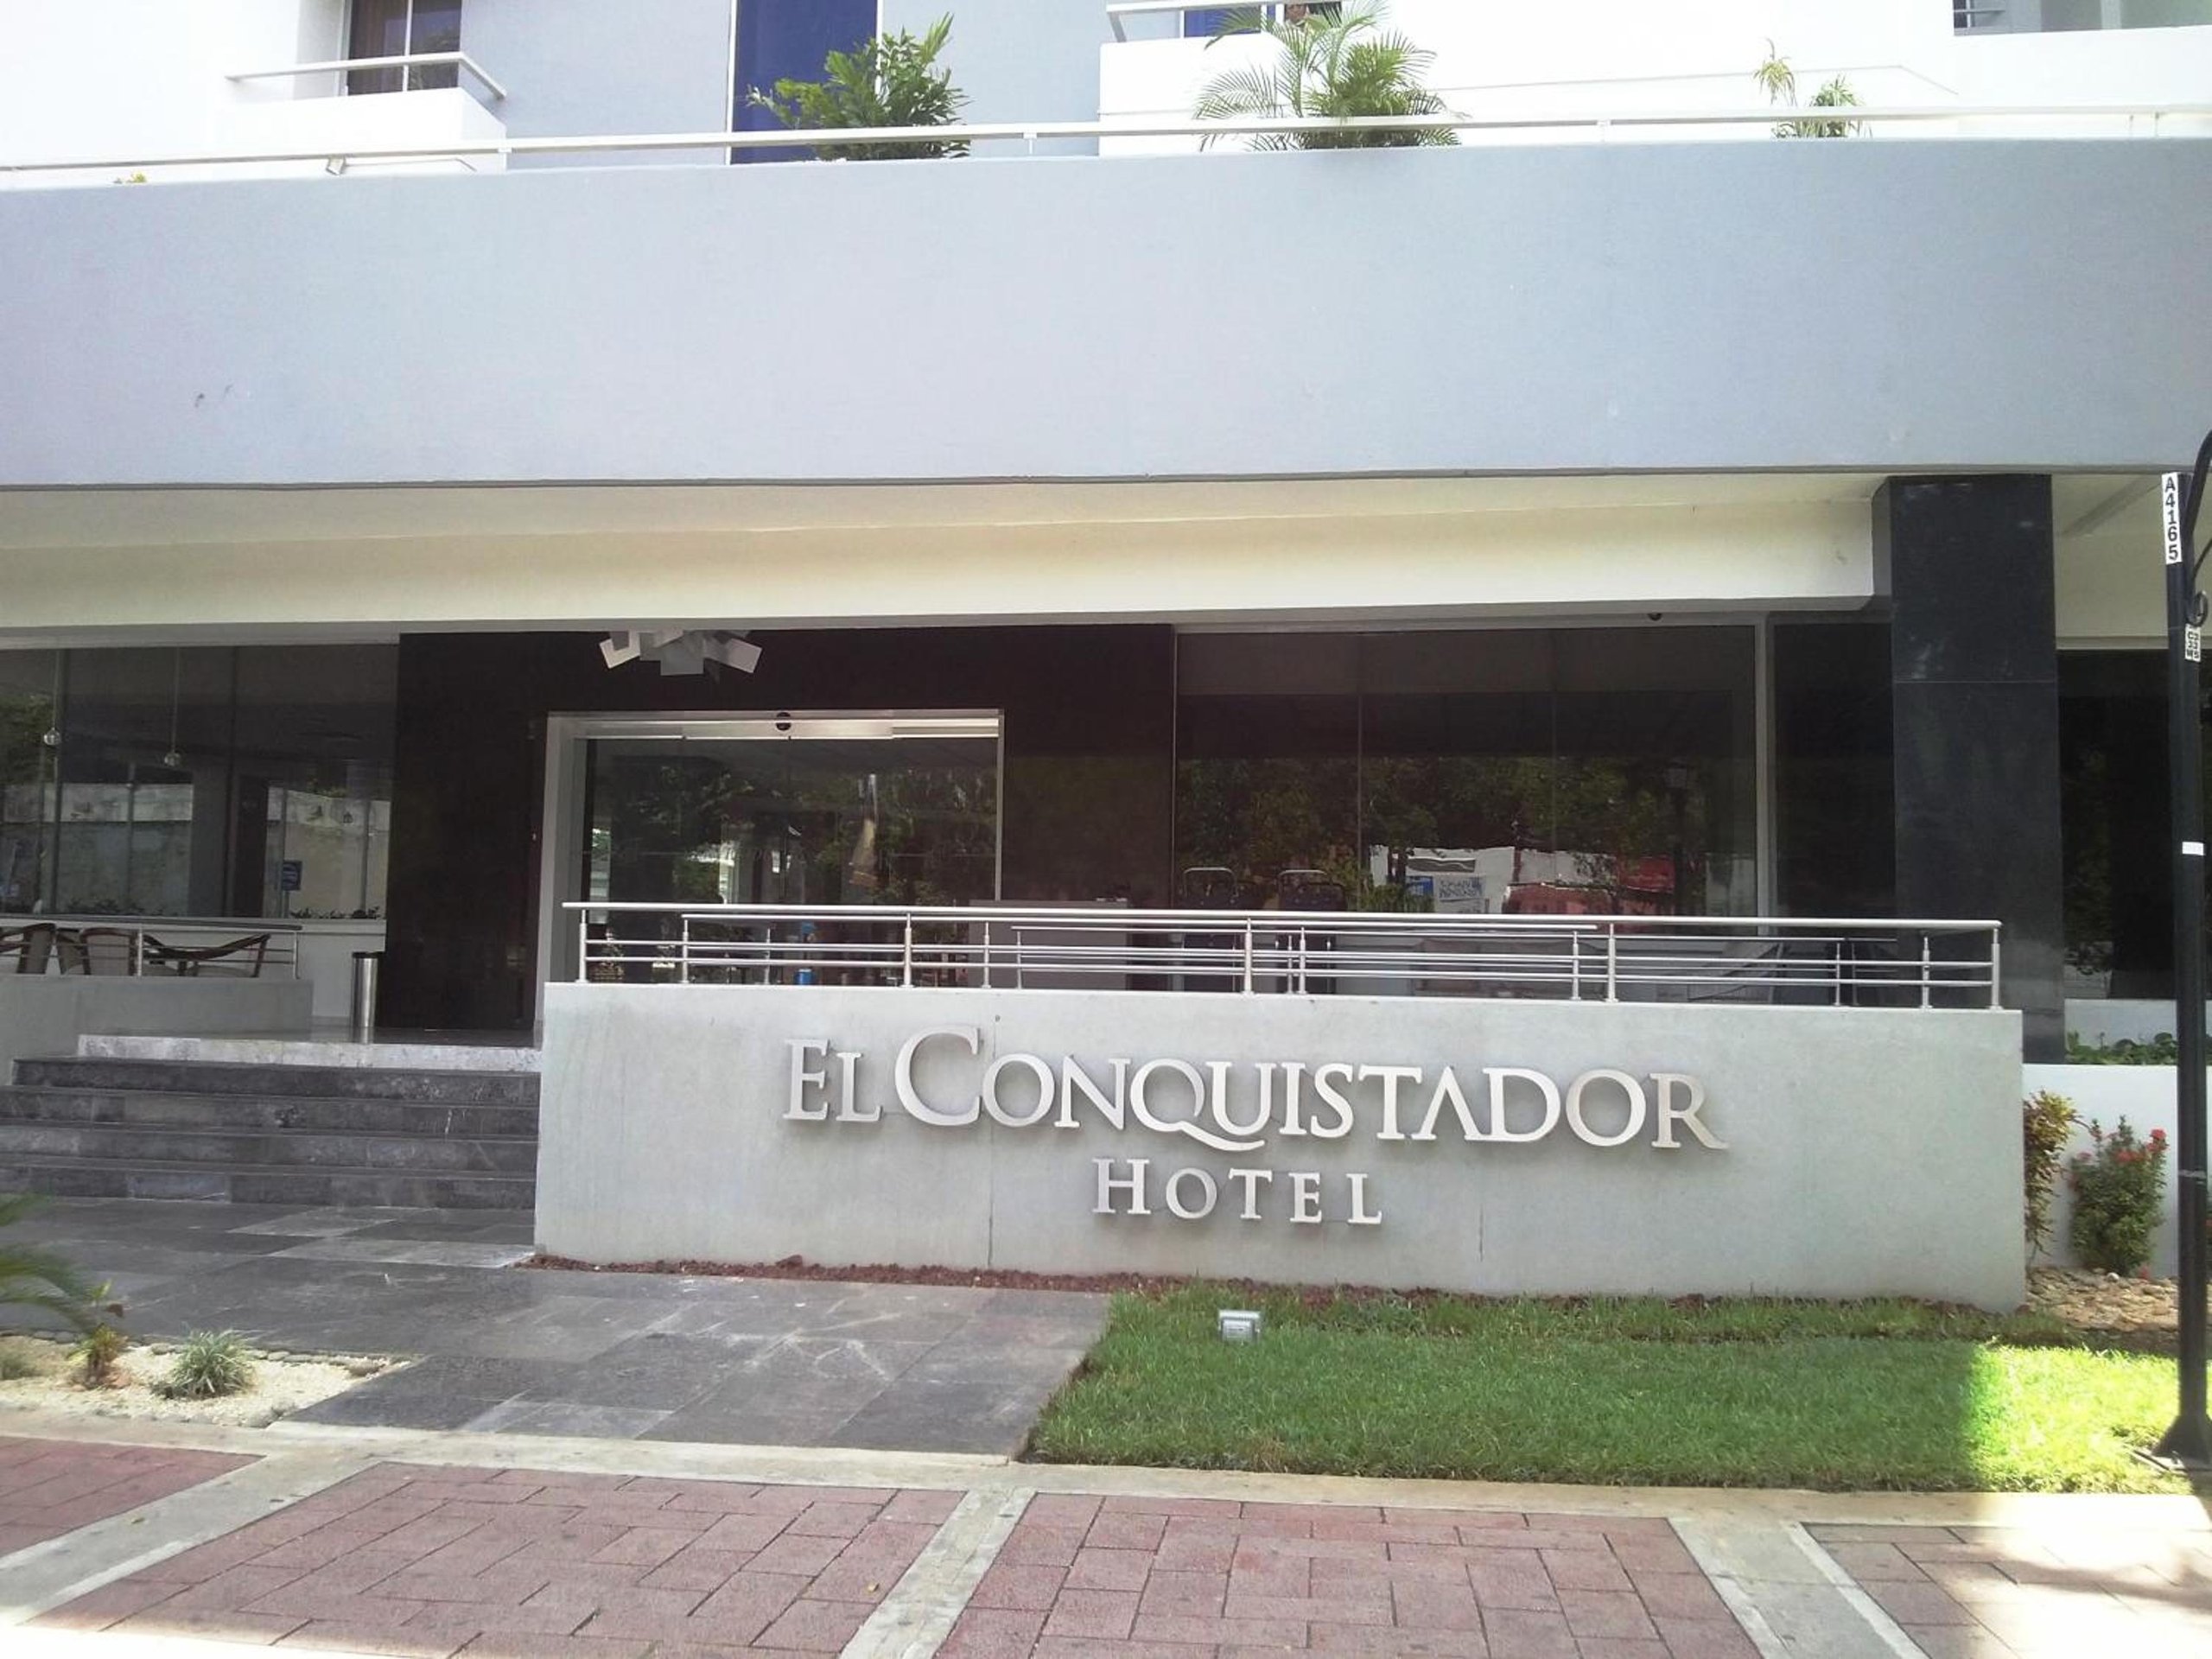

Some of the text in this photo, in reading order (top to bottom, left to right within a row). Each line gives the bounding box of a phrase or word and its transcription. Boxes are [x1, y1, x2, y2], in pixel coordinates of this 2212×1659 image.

[2164, 476, 2178, 561] A4165
[782, 1025, 1730, 1152] EL CONQUISTADOR
[1091, 1158, 1382, 1224] HOTEL
